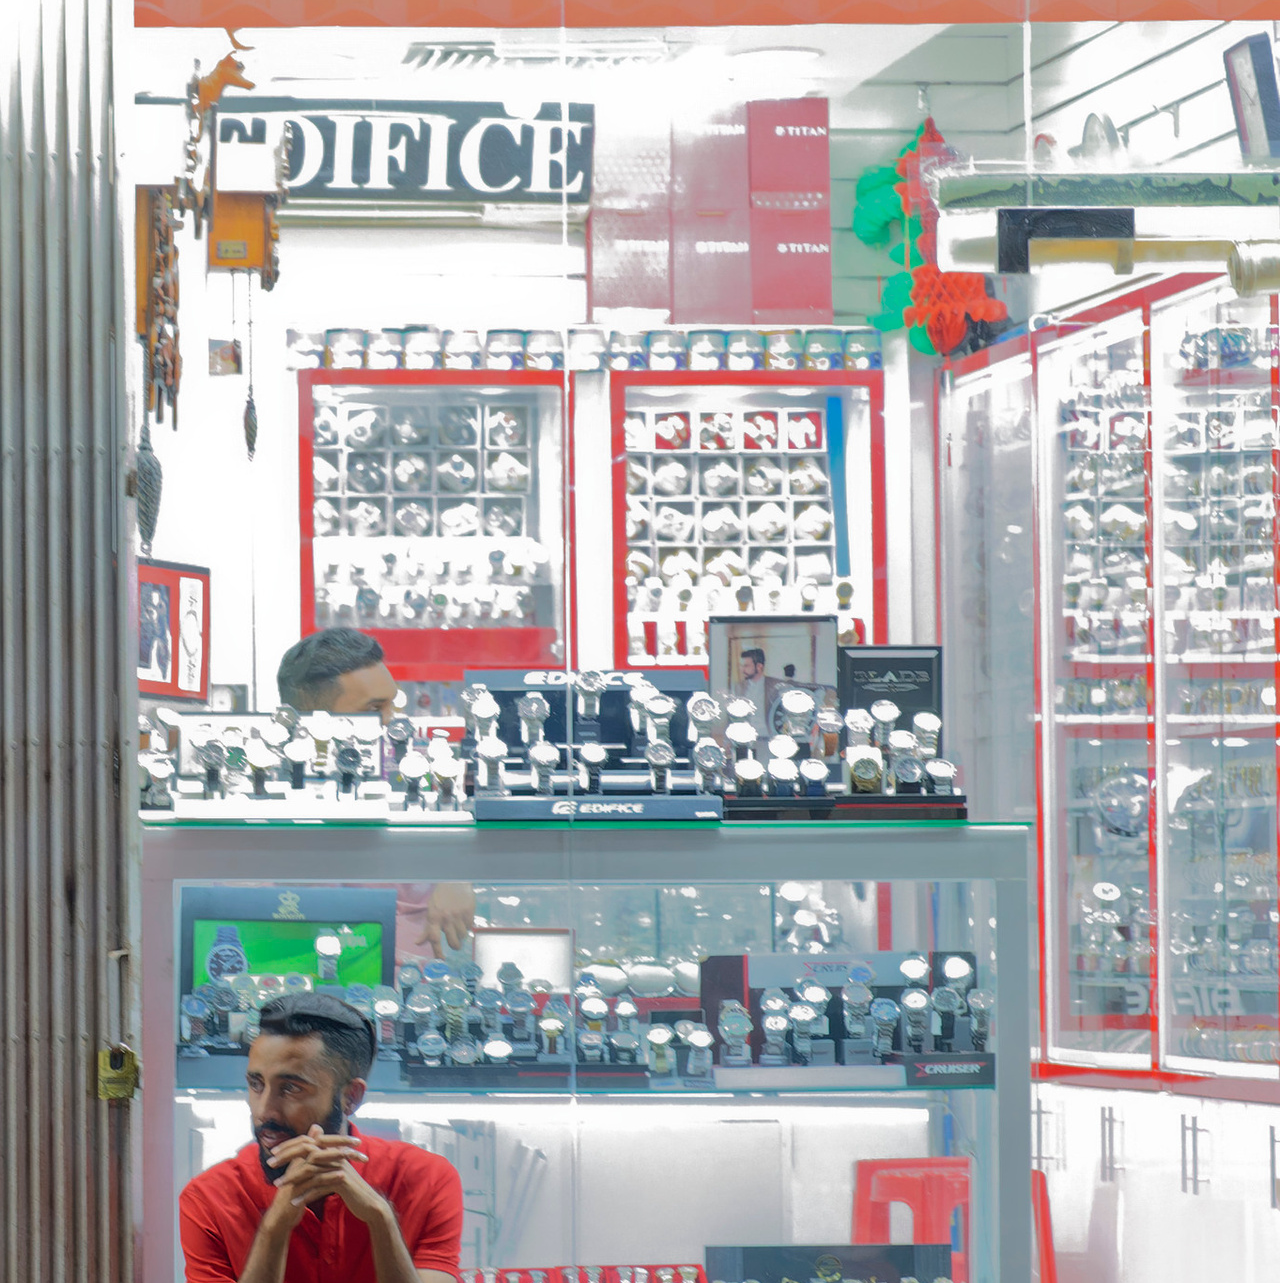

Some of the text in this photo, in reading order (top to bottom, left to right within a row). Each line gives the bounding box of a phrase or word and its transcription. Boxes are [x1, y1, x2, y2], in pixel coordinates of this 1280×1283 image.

[786, 125, 827, 136] TITAN
[790, 243, 829, 254] TITAN
[579, 802, 645, 814] EDIFICE
